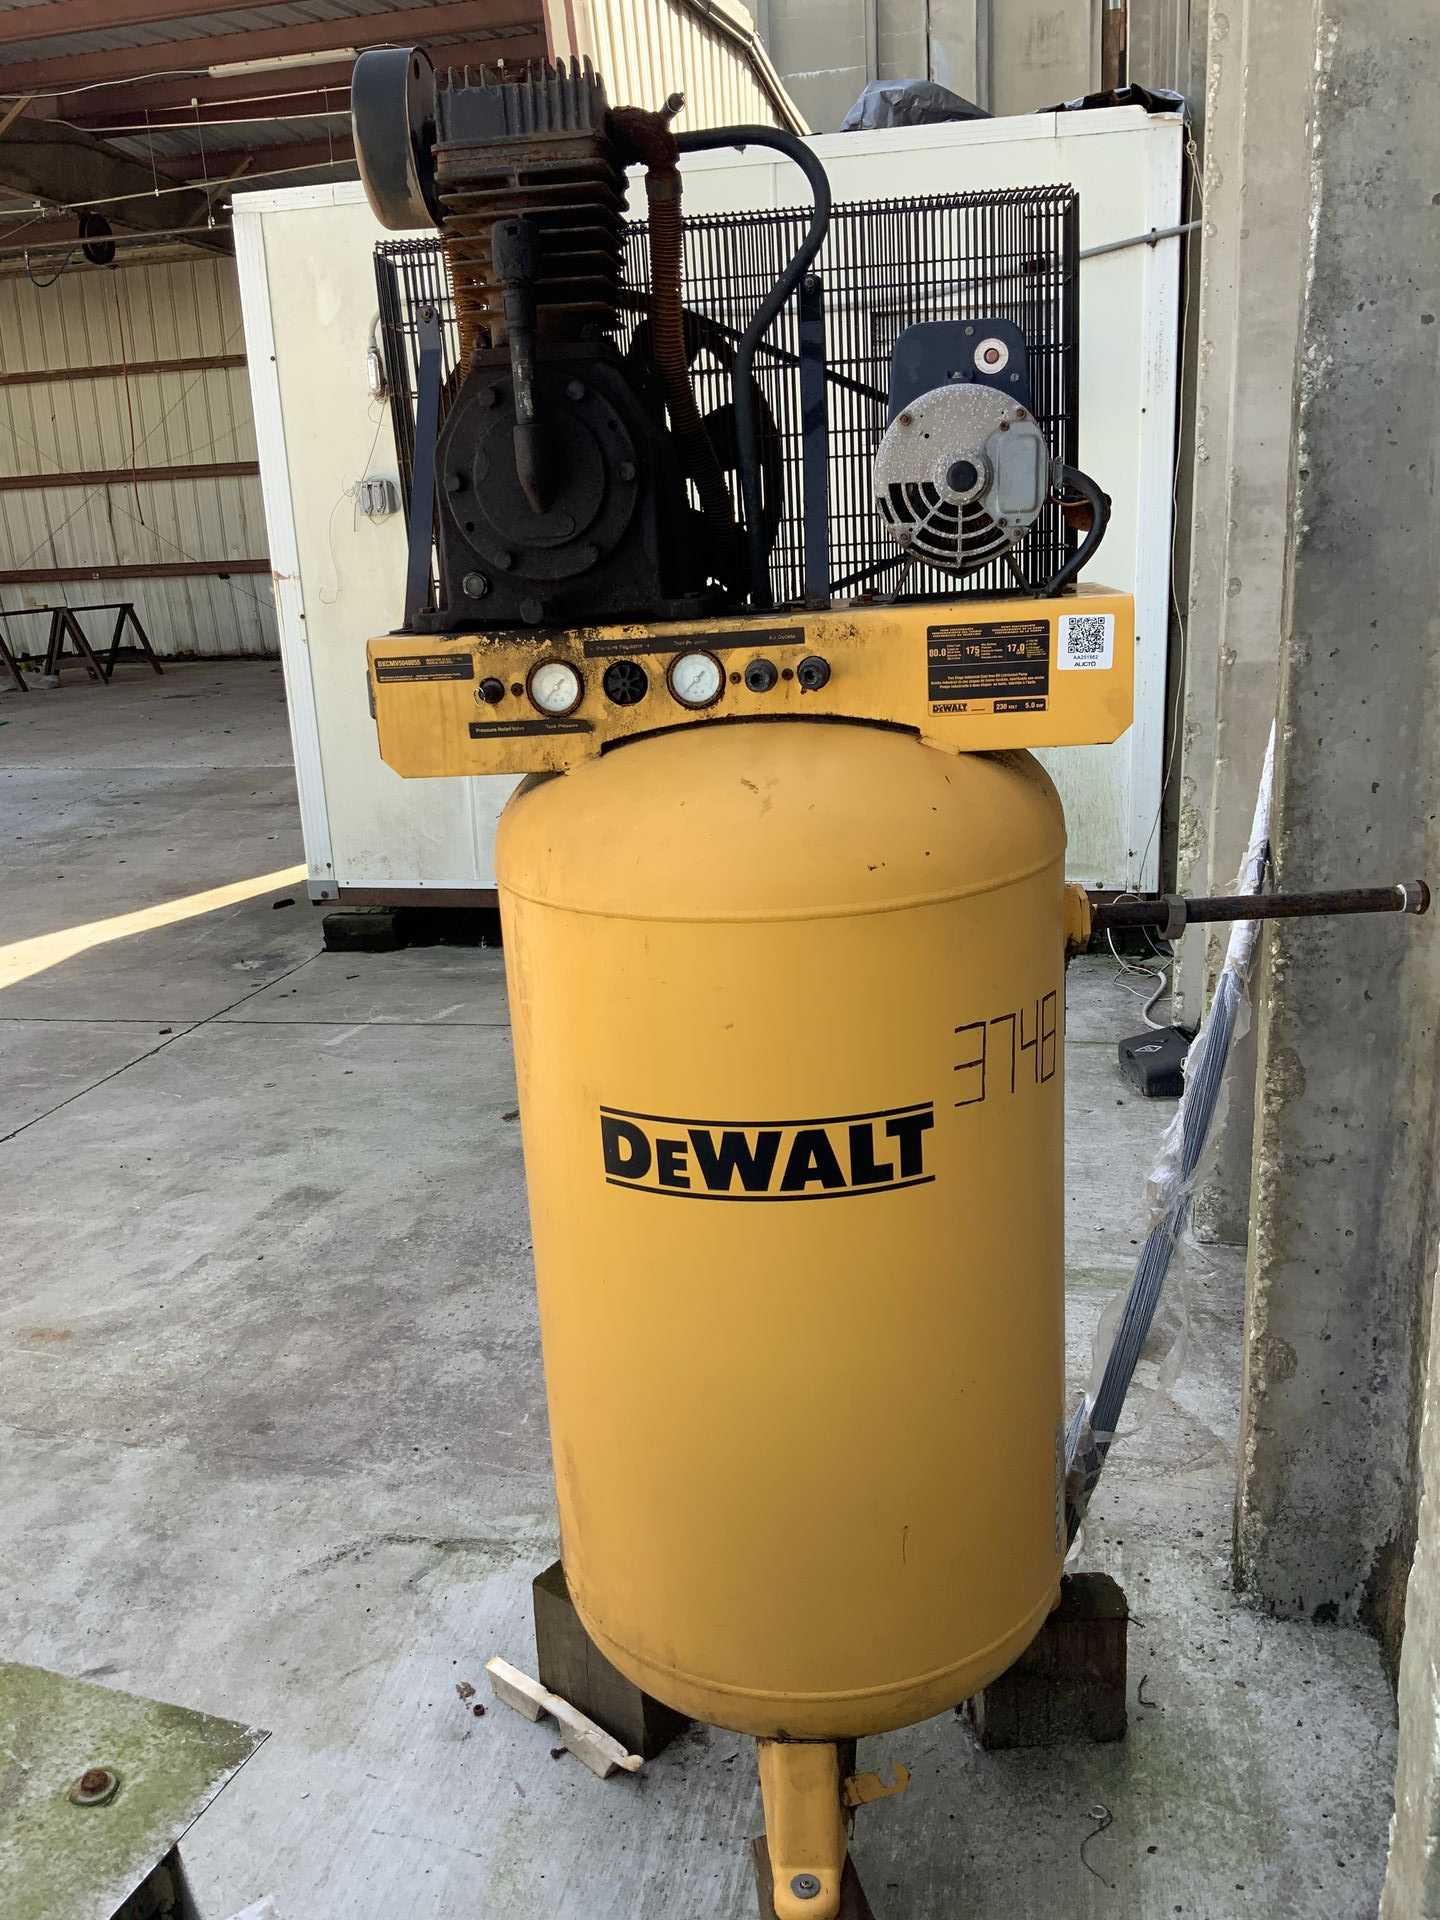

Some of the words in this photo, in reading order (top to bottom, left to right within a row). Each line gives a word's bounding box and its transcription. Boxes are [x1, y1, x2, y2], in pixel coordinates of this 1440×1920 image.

[965, 645, 980, 655] 175
[1007, 643, 1025, 653] 17.0
[953, 989, 1057, 1107] 3748
[600, 1110, 935, 1192] DEWALT
